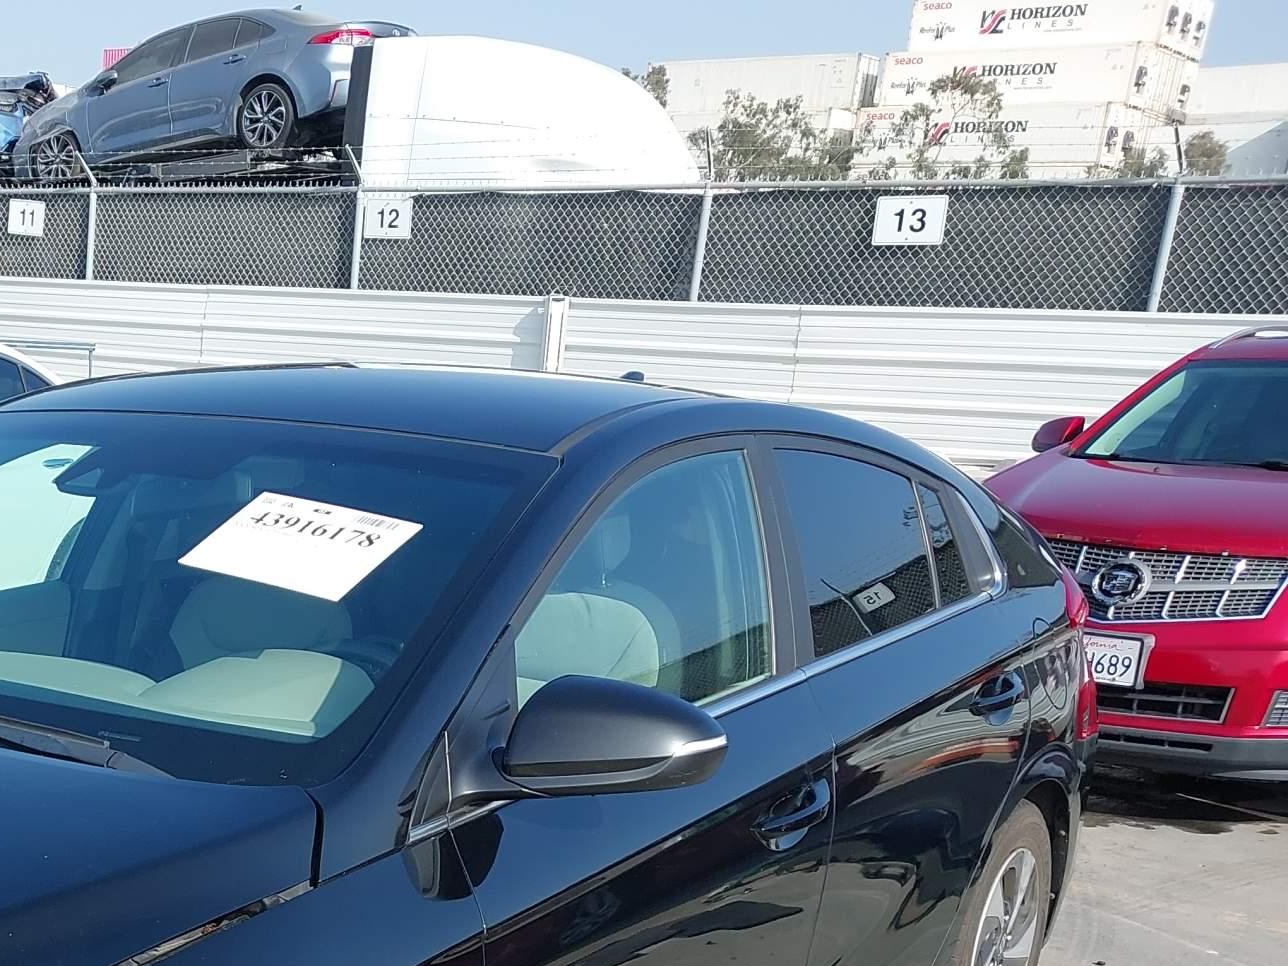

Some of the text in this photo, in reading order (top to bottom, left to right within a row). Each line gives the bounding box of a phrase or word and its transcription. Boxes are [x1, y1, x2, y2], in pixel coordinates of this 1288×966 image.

[923, 1, 952, 10] seaco
[1009, 4, 1088, 20] HORIZON
[1007, 19, 1074, 30] LINES
[894, 57, 923, 65] seaco
[981, 62, 1058, 76] HORIZON
[866, 112, 895, 120] seaco
[953, 120, 1029, 133] HORIZON
[20, 209, 35, 227] 11
[377, 208, 400, 229] 12
[893, 208, 927, 233] 13
[250, 511, 381, 548] 43916178
